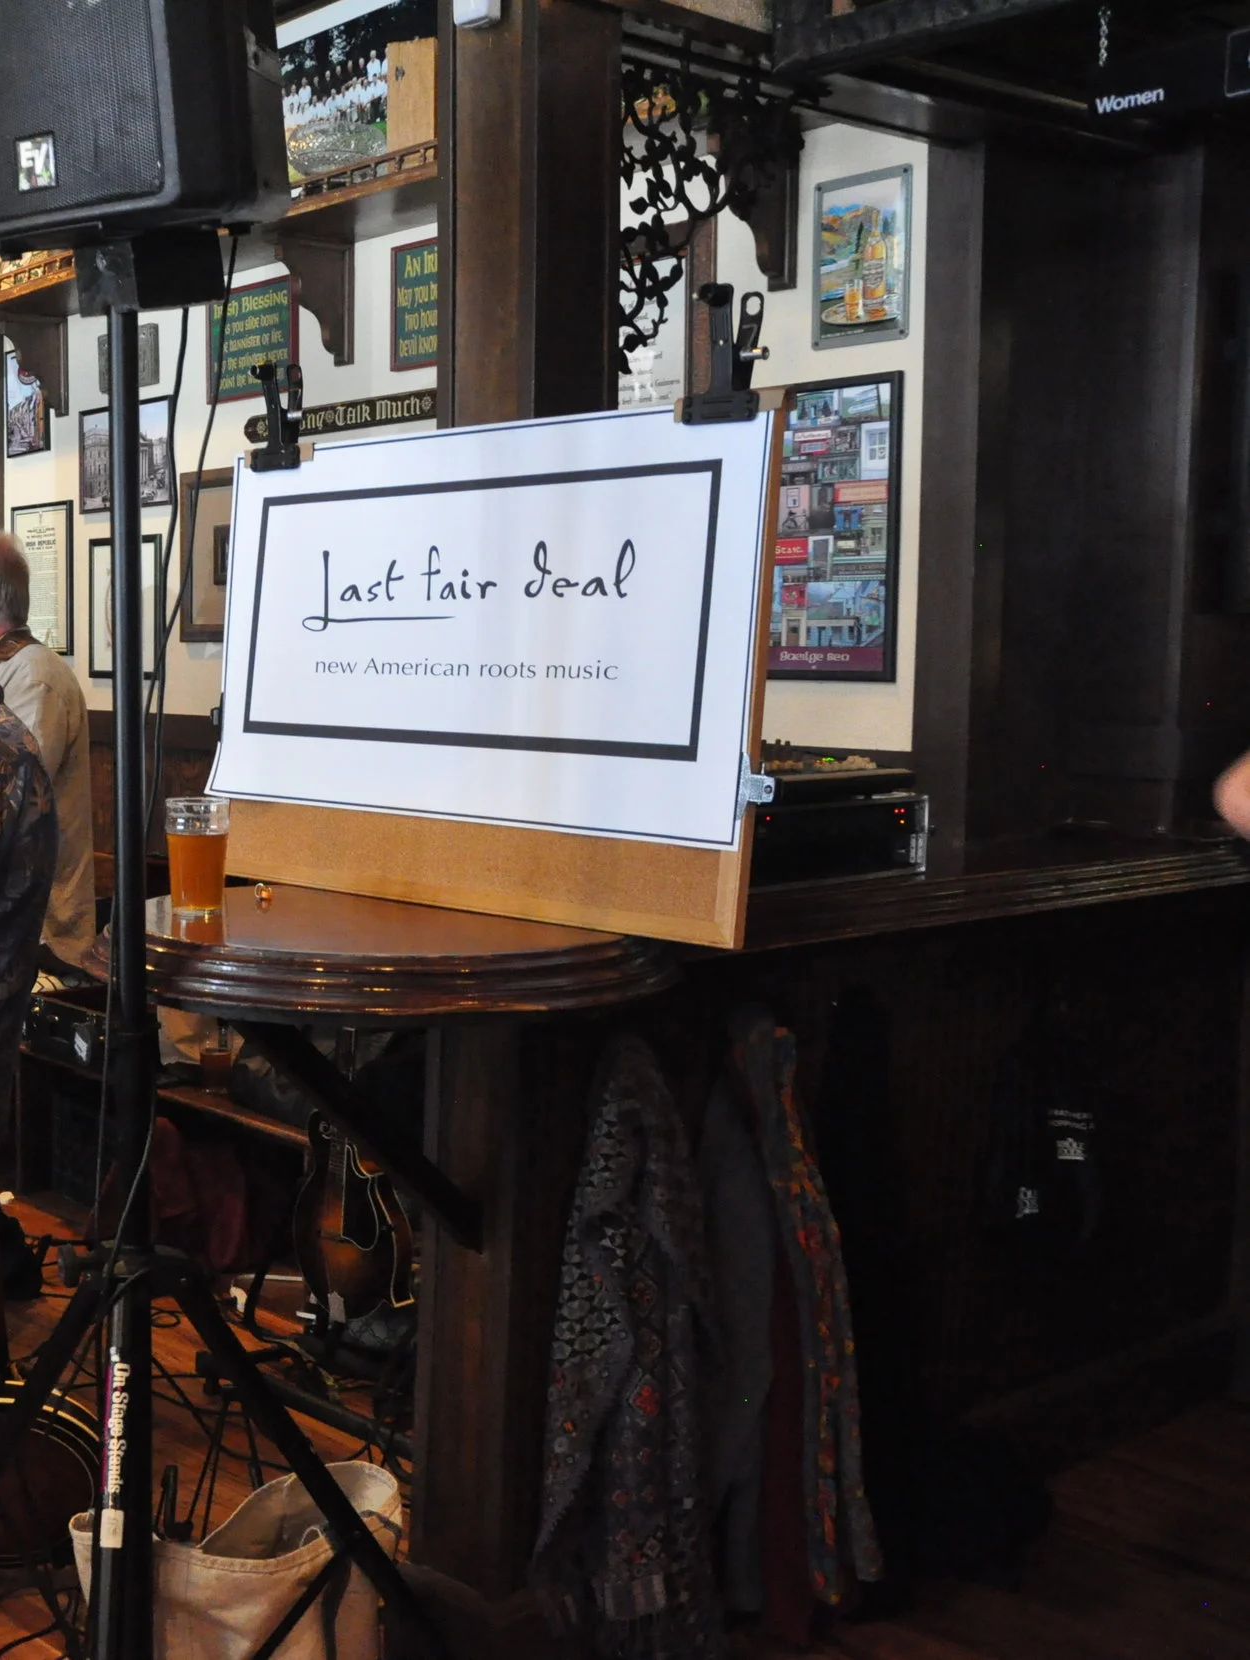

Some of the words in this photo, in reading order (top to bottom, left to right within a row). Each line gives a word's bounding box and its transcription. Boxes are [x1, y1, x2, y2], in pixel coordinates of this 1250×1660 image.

[1095, 88, 1165, 115] Women
[335, 403, 371, 427] Talk
[376, 395, 421, 420] Much
[302, 550, 454, 632] Last
[420, 545, 497, 601] fair
[524, 539, 635, 598] deal
[315, 659, 358, 674] new
[364, 657, 470, 677] American
[480, 661, 537, 679] roots
[546, 659, 619, 680] music
